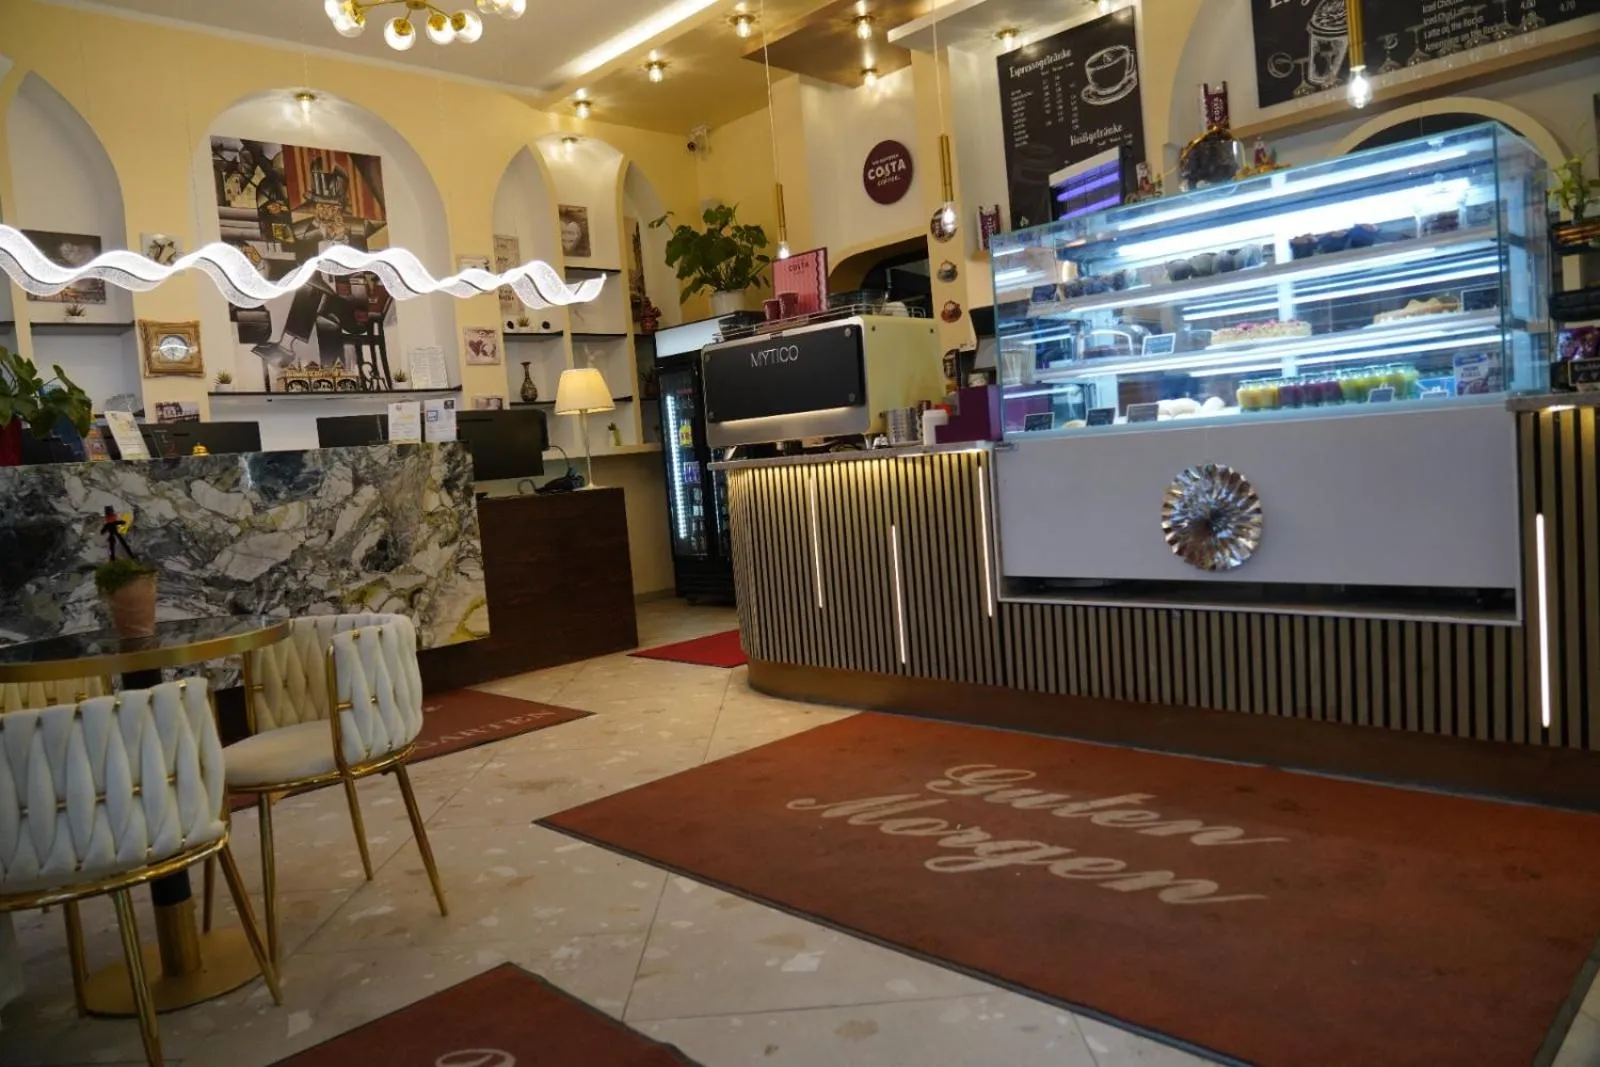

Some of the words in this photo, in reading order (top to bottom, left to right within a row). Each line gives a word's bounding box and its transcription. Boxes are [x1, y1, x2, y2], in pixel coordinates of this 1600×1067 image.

[867, 158, 906, 181] COSTA
[750, 345, 799, 368] MYTICO
[926, 764, 1292, 847] Guten
[786, 793, 1270, 905] Morgen
